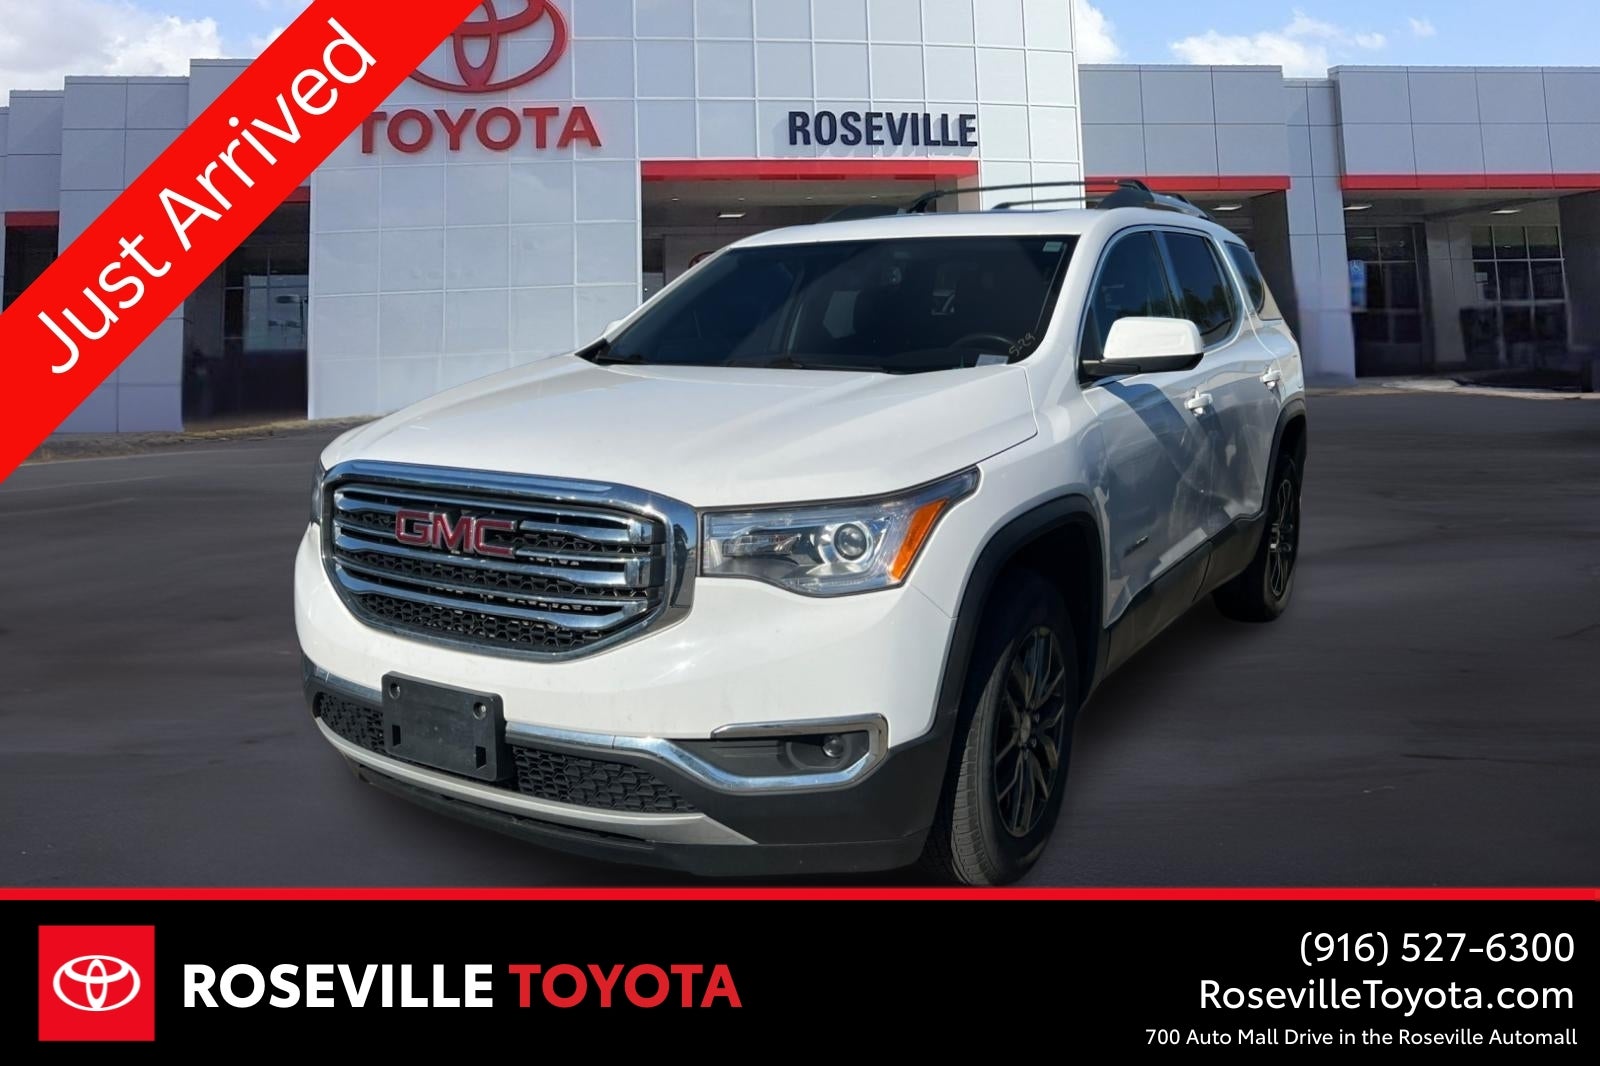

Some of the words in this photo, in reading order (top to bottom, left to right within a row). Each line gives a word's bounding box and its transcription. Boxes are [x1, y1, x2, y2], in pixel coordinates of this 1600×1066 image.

[361, 106, 602, 153] TOYOTA
[788, 110, 978, 147] ROSEVILLE
[394, 509, 518, 559] GMC
